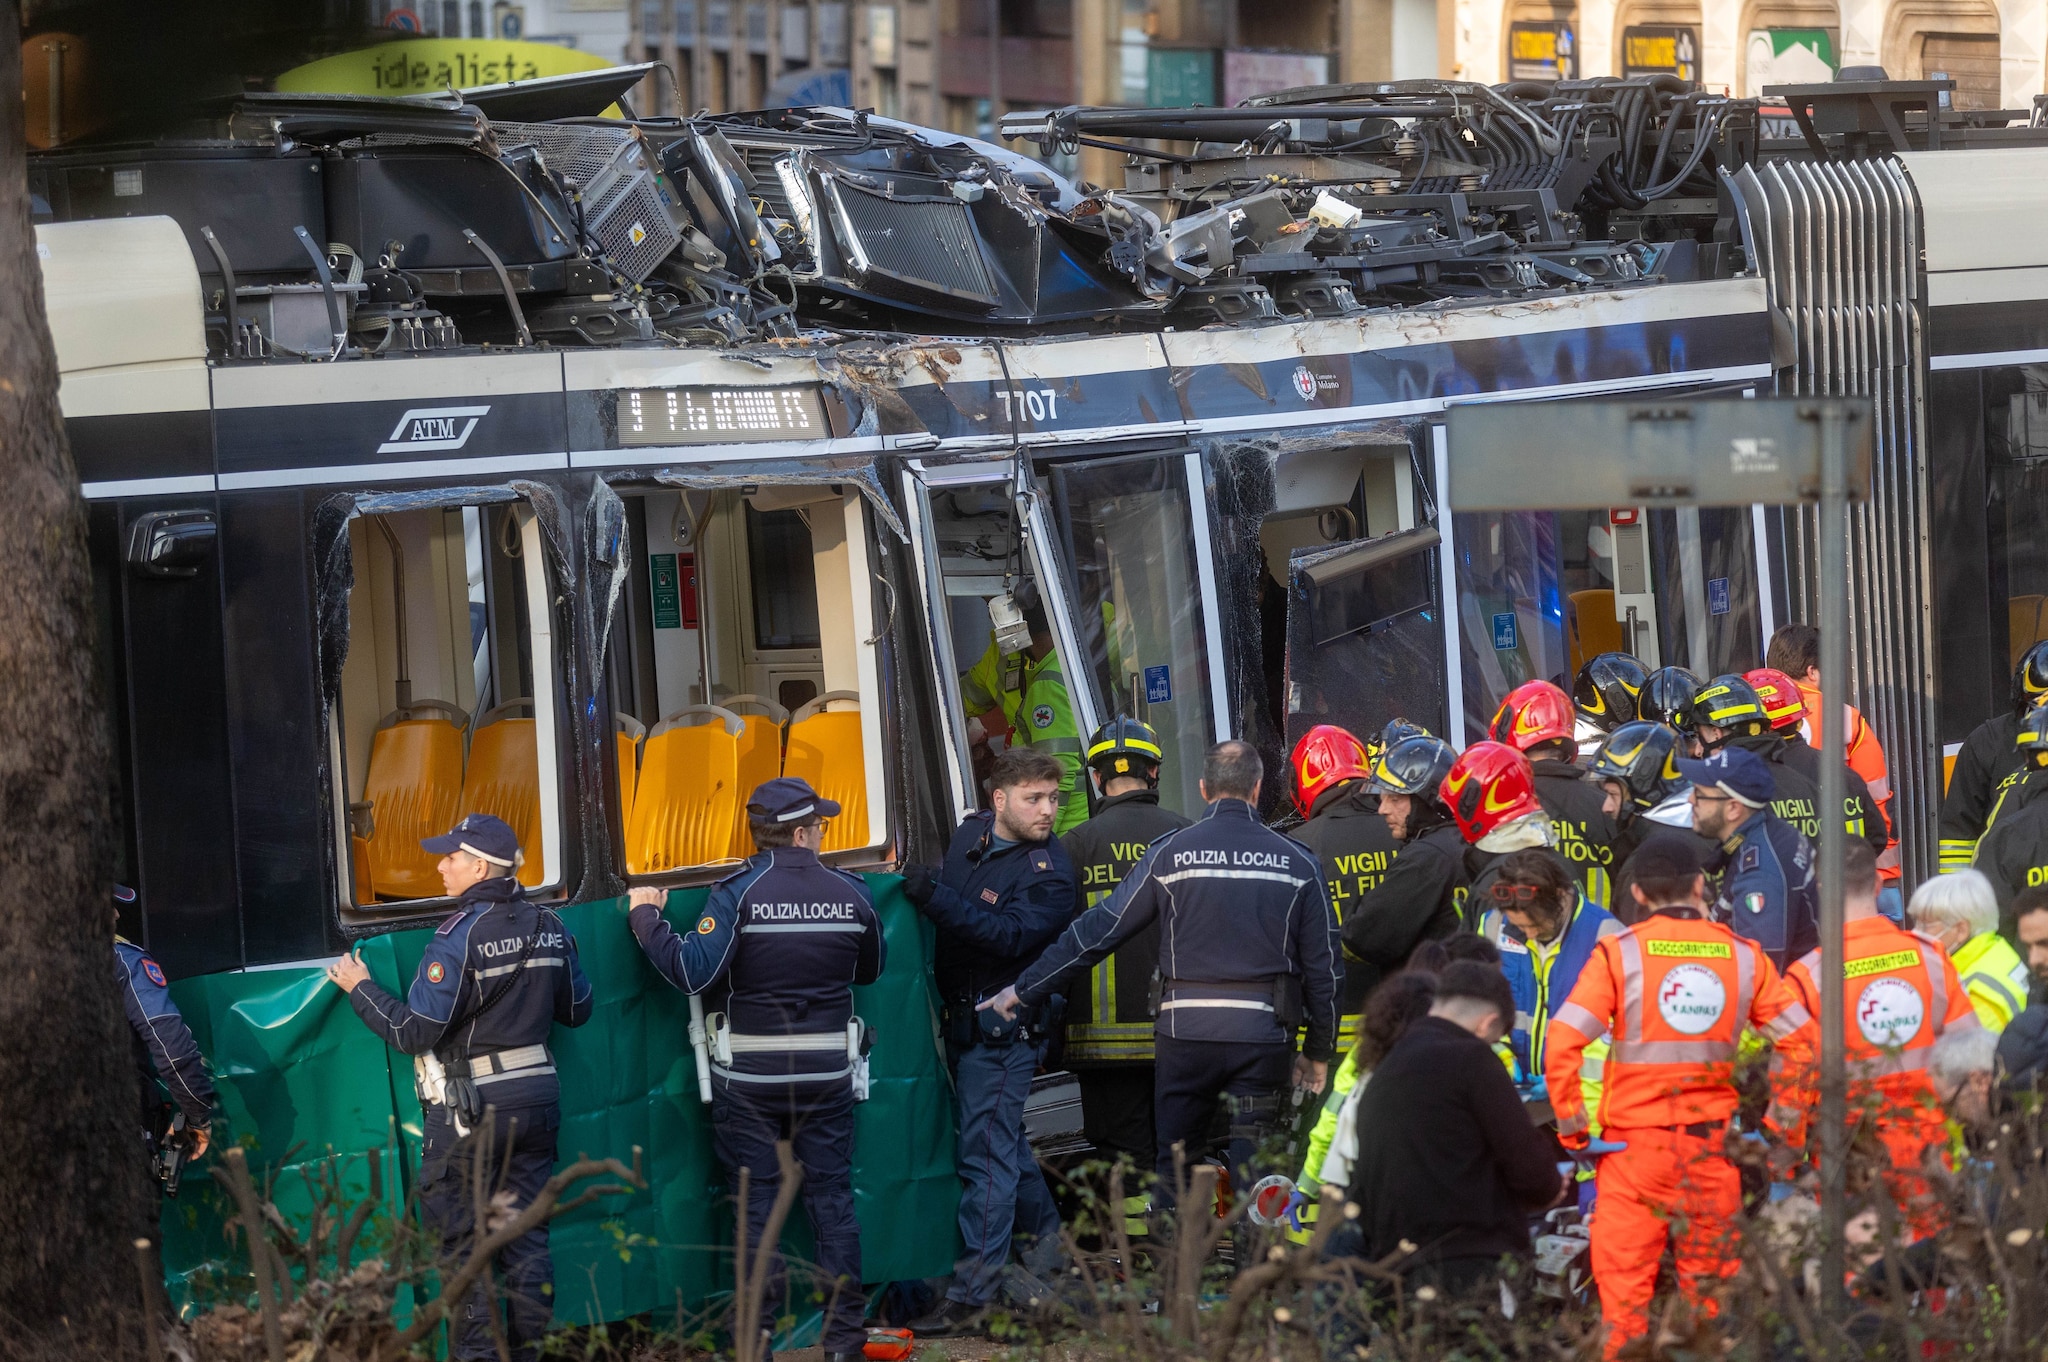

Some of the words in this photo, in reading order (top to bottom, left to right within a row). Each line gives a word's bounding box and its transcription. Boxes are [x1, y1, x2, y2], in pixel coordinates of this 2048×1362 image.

[371, 52, 538, 89] idealista
[1317, 381, 1340, 389] Milano
[995, 388, 1058, 421] 7707
[411, 417, 456, 441] ATM
[1770, 799, 1815, 820] VIGILI
[1174, 850, 1228, 868] POLIZIA
[1233, 851, 1290, 869] LOCALE
[751, 904, 801, 919] POLIZIA
[803, 902, 854, 919] LOCALE
[477, 936, 524, 959] POLIZIA
[1651, 942, 1728, 957] SOCCORRITORE
